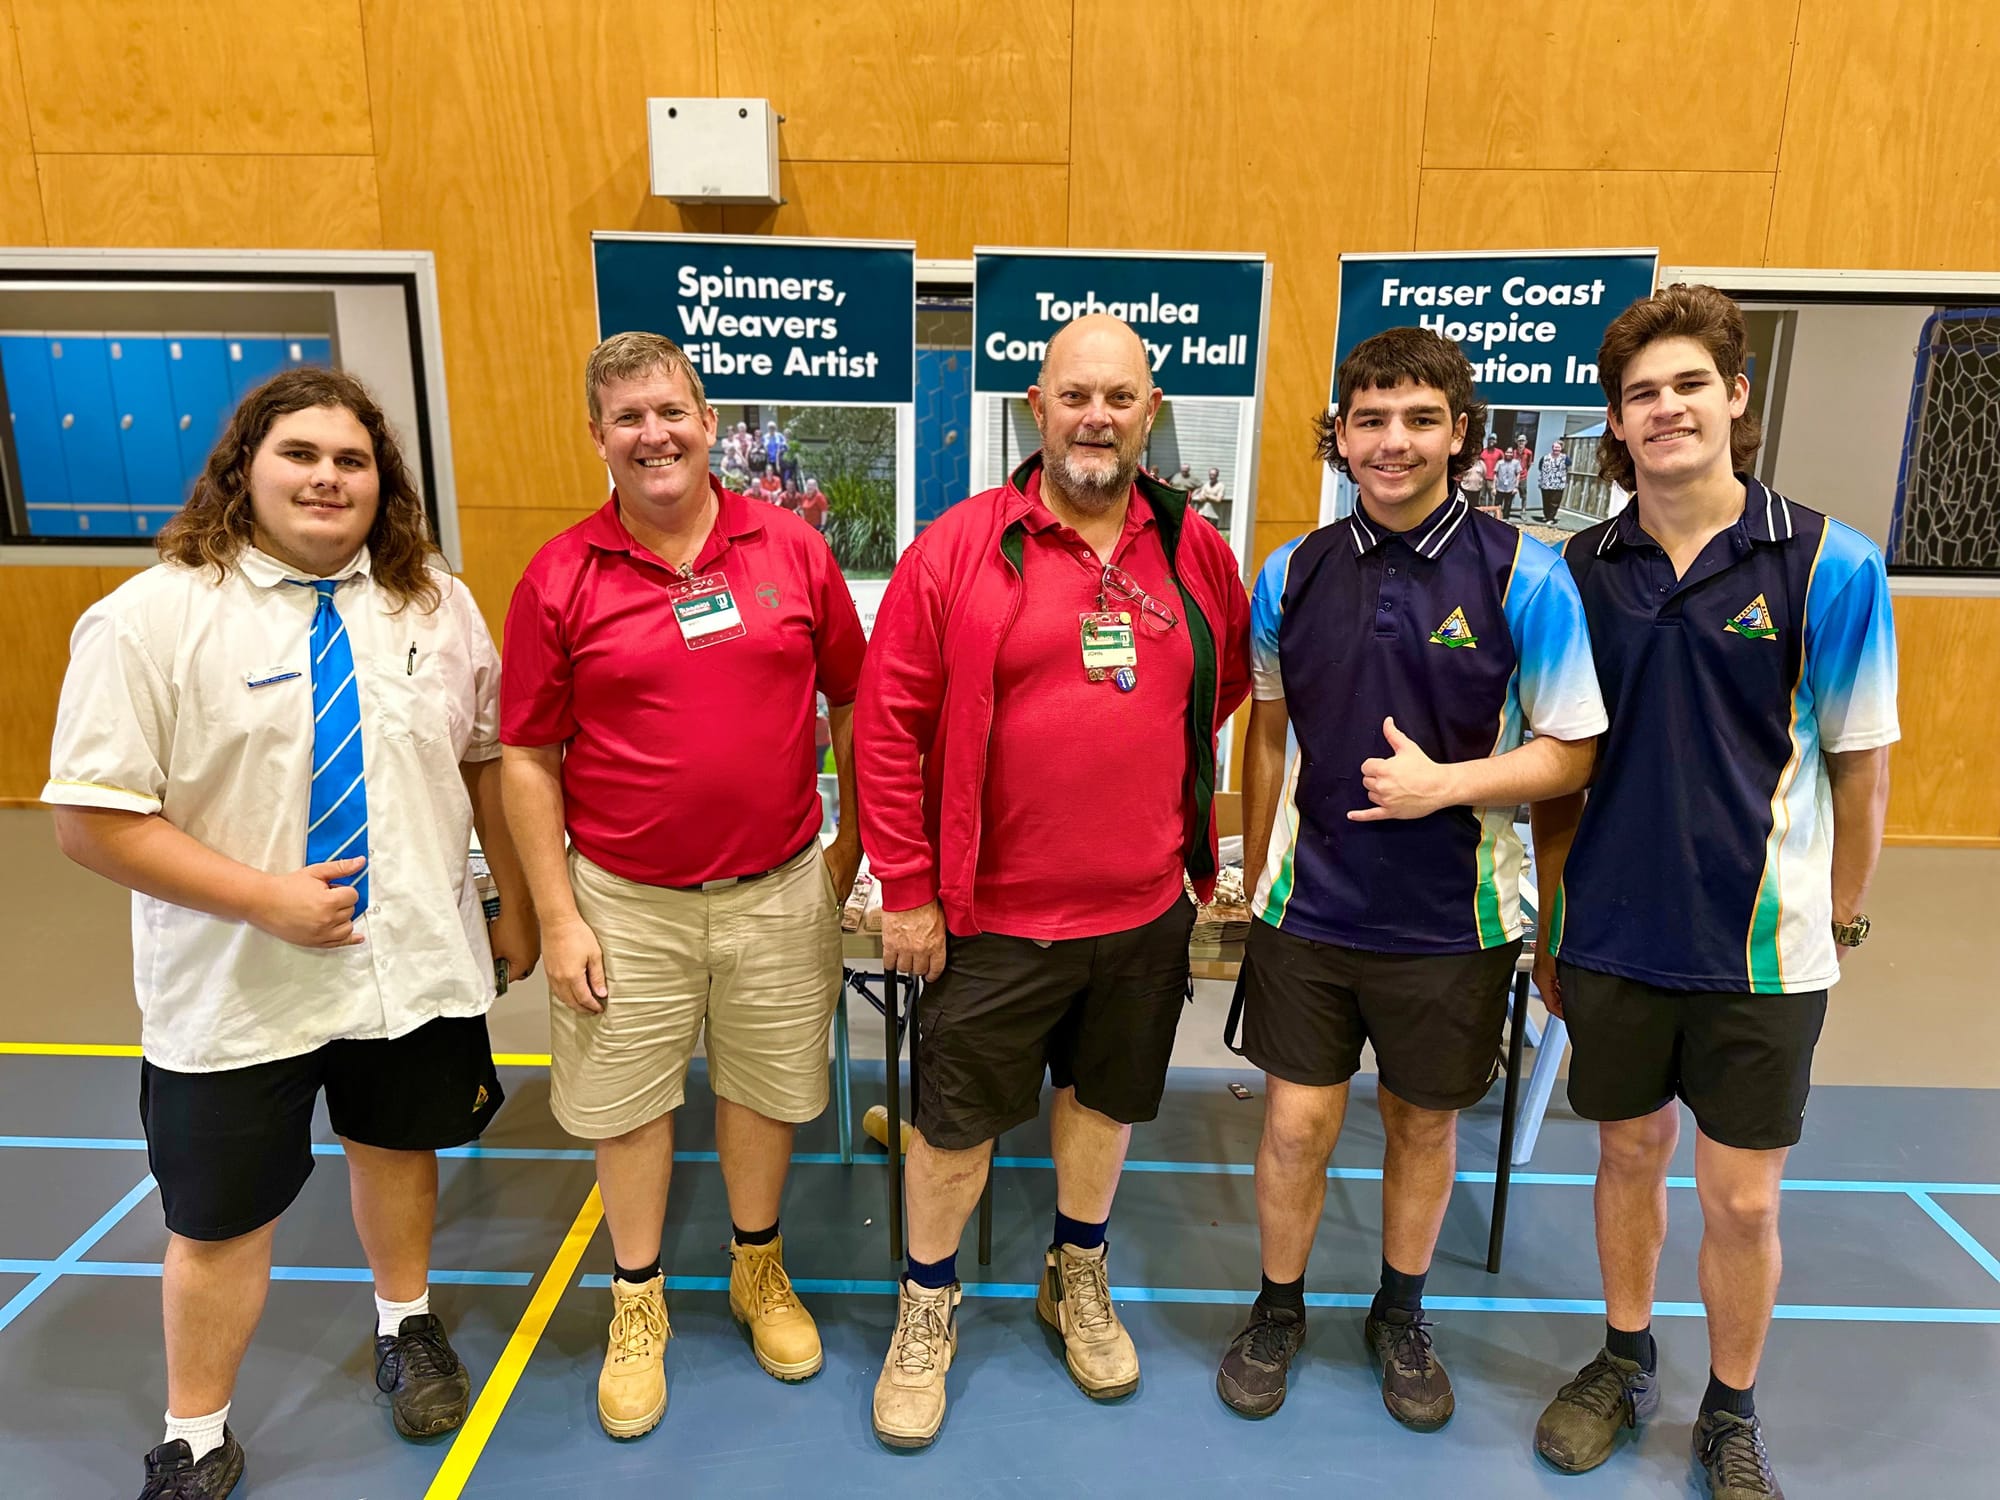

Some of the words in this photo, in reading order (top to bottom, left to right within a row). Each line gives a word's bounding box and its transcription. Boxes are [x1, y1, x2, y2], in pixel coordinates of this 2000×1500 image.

[677, 265, 846, 306] Spinners,
[1381, 278, 1492, 307] Fraser
[1502, 275, 1607, 306] Coast
[677, 304, 838, 340] Weavers
[1035, 291, 1200, 324] Torbanlea
[1418, 312, 1557, 351] Hospice
[683, 341, 774, 376] Fibre
[783, 345, 879, 378] Artist
[1181, 334, 1248, 365] Hall
[1565, 355, 1600, 385] In
